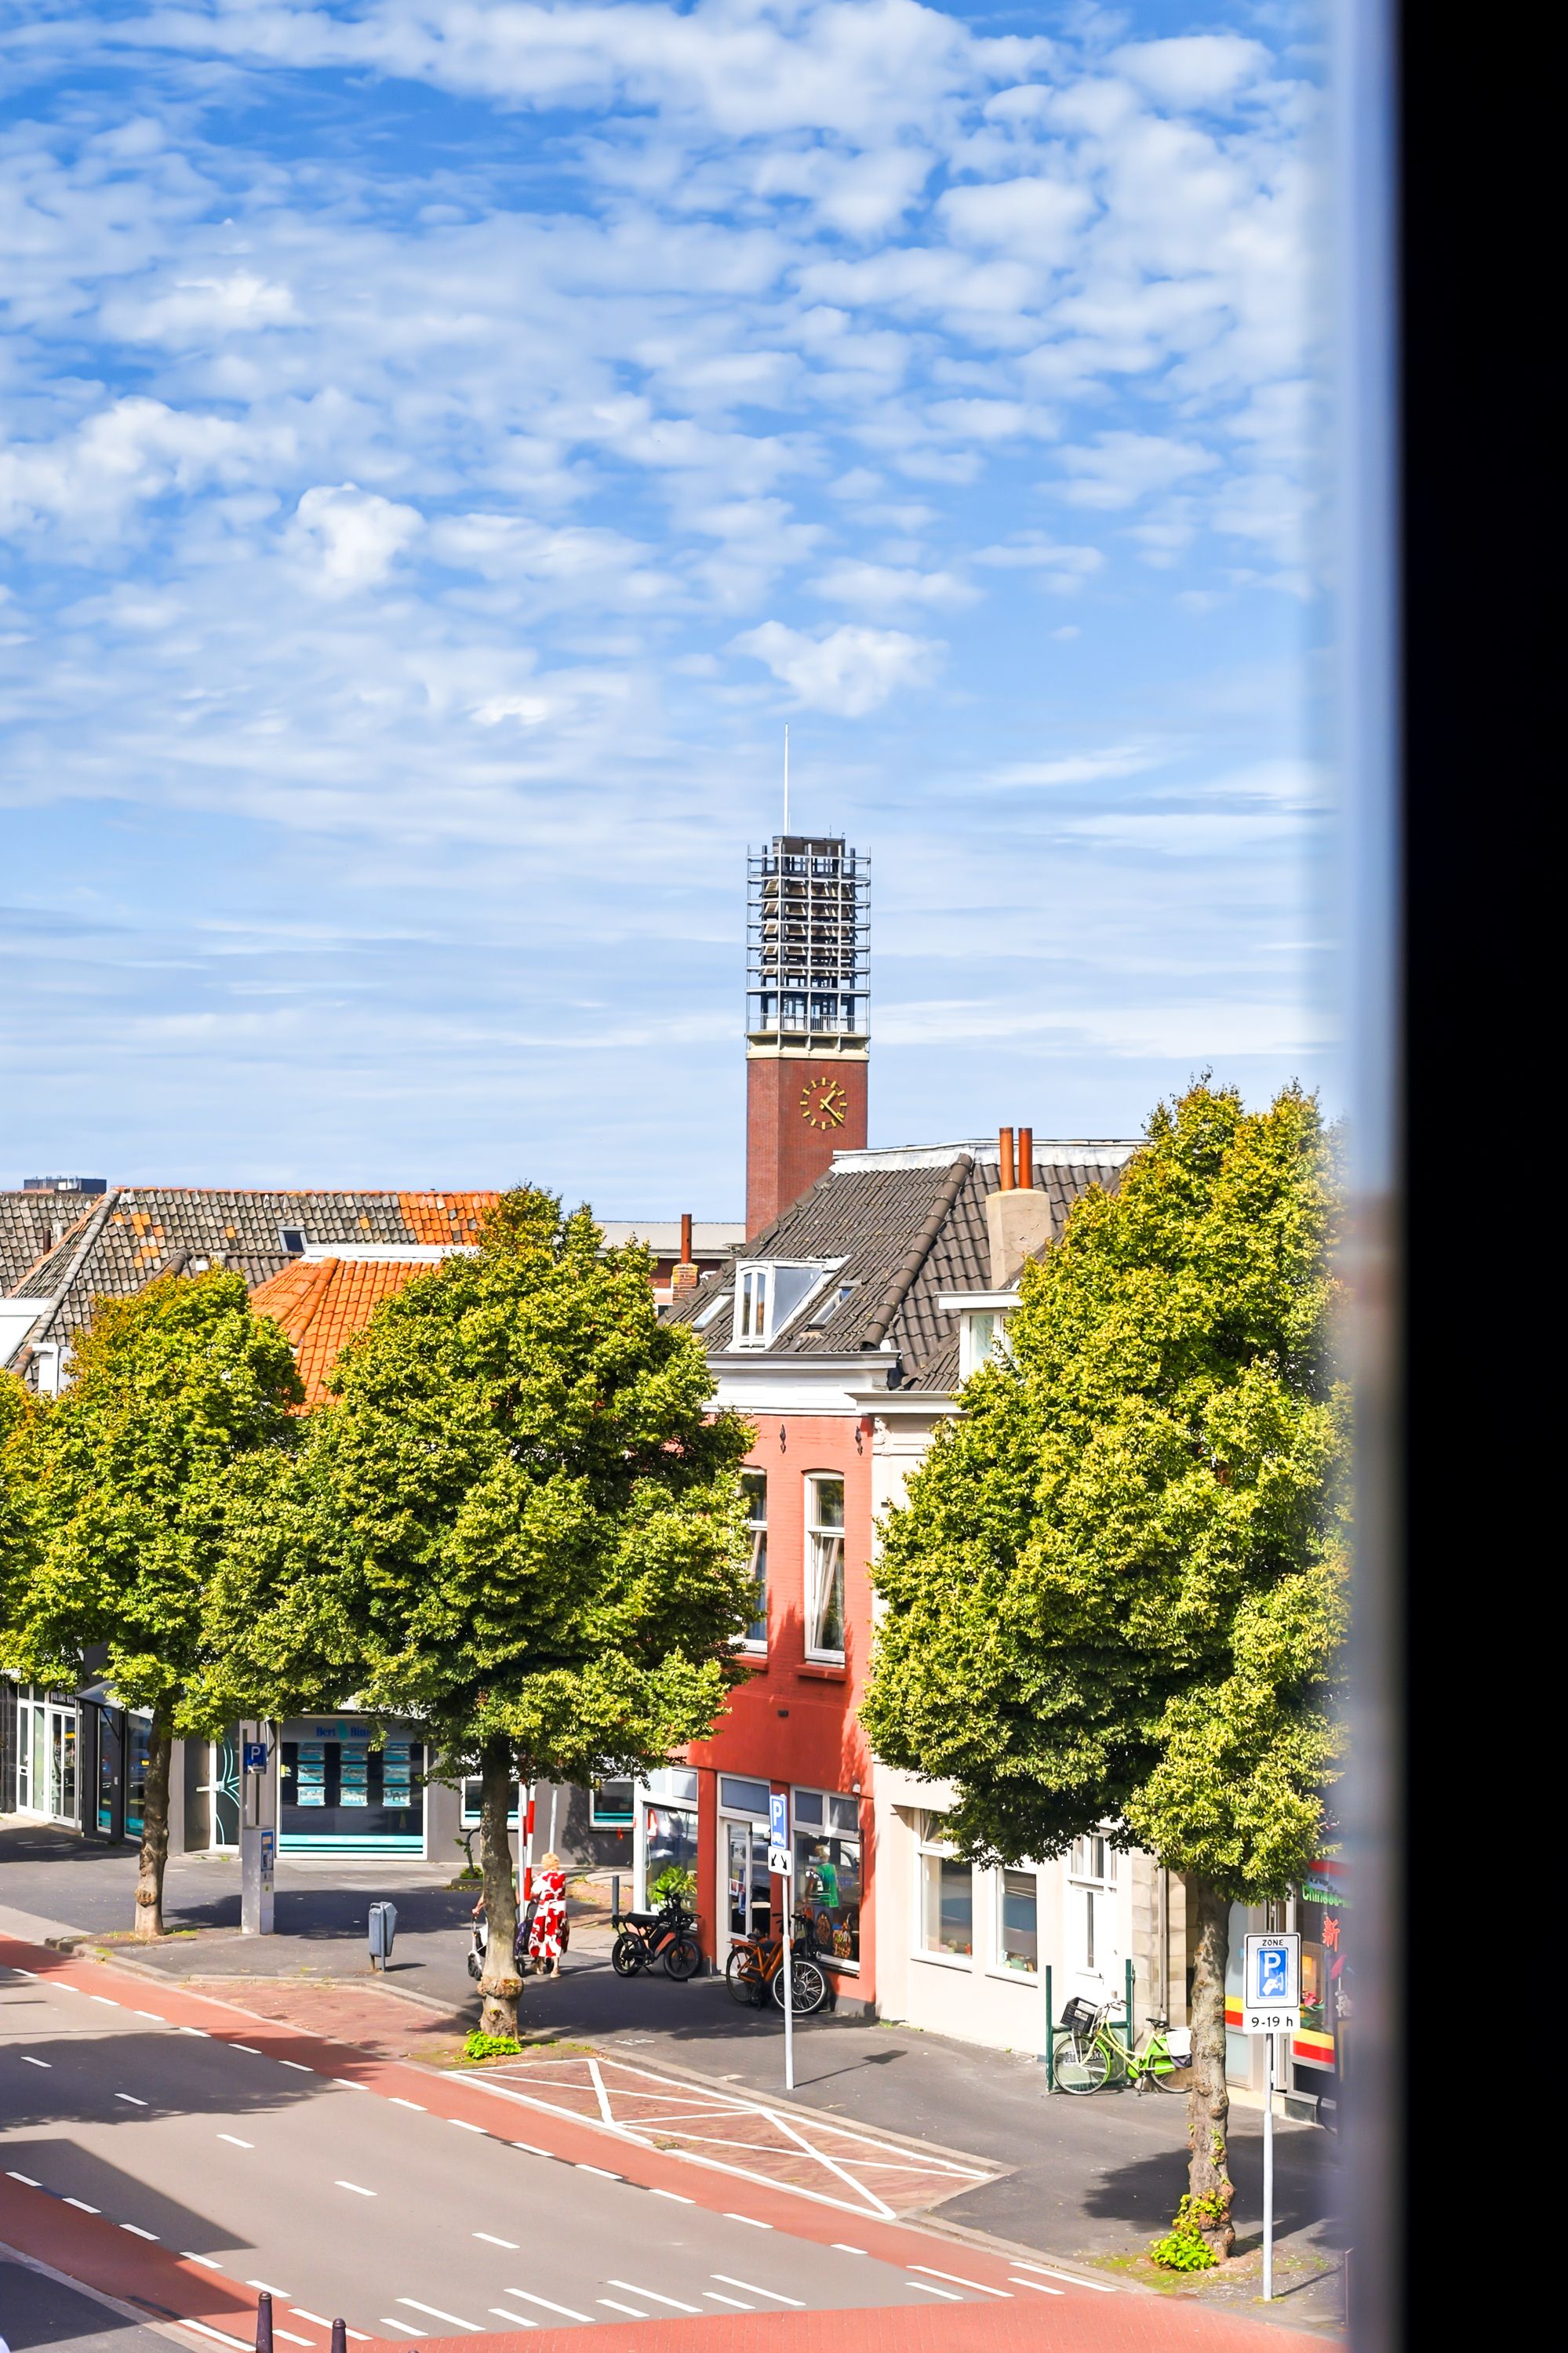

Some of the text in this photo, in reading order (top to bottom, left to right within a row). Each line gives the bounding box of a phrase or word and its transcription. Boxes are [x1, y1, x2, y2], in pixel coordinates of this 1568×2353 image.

[316, 1727, 337, 1737] Bert
[251, 1746, 261, 1760] P
[773, 1800, 783, 1827] P
[1322, 1916, 1341, 1952] 新
[1264, 1951, 1282, 1977] P
[1251, 2016, 1293, 2028] 9-19 h
